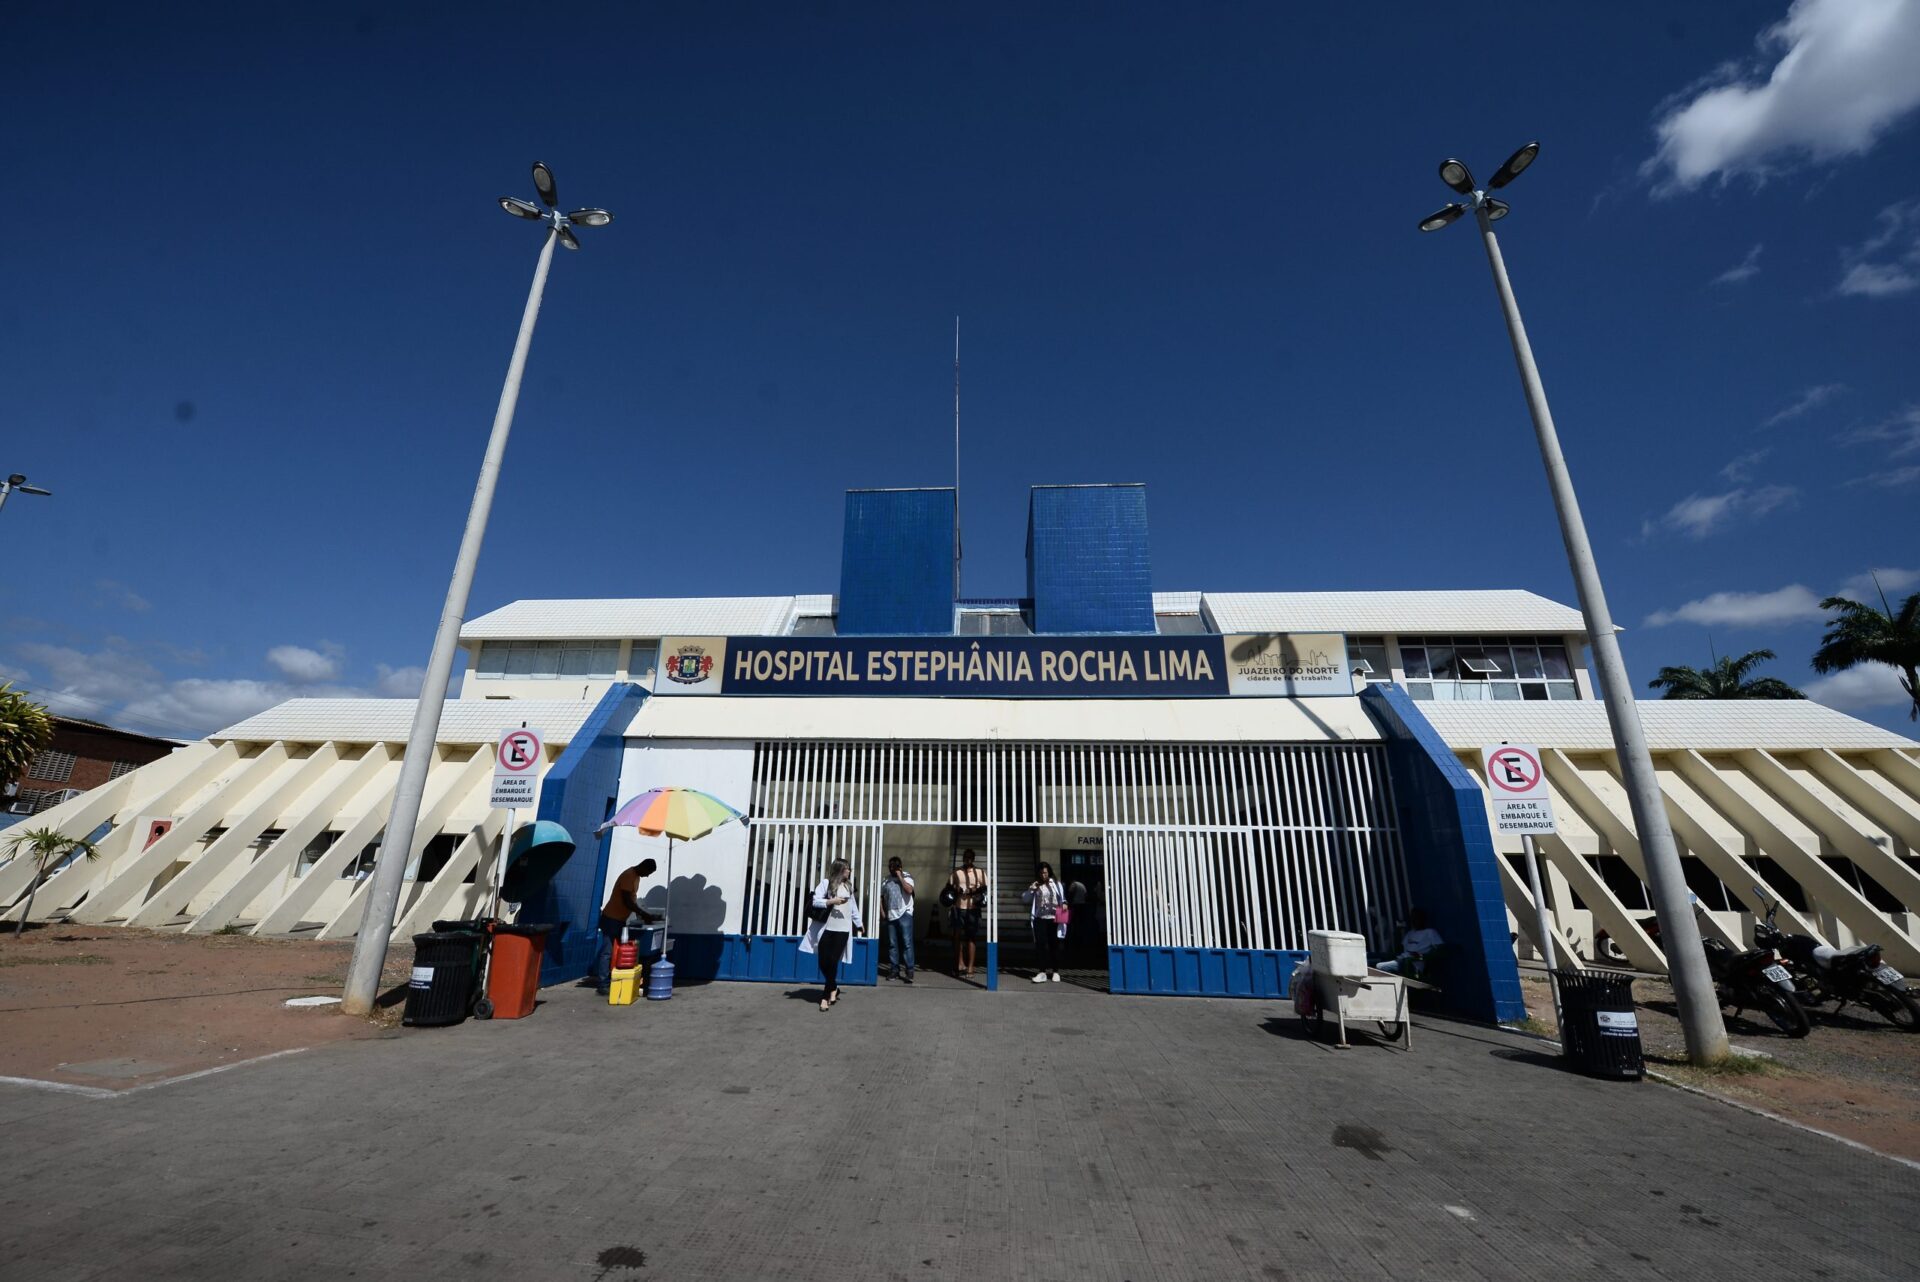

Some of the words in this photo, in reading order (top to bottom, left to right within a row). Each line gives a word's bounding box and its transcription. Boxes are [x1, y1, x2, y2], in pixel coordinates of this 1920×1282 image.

[734, 650, 860, 681] HOSPITAL
[867, 641, 1034, 681] ESTEPHÂNIA
[1041, 650, 1138, 681] ROCHA
[1145, 649, 1215, 681] LIMA
[1238, 667, 1286, 675] JUAZEIRO
[1289, 667, 1303, 675] DO
[1306, 667, 1340, 675] NORTE
[511, 740, 528, 762] E
[1503, 757, 1525, 782] E
[1527, 802, 1538, 810] DE
[1500, 812, 1541, 820] EMBARQUE
[1499, 821, 1554, 829] DESEMBARQUE
[1078, 836, 1107, 845] FARM
